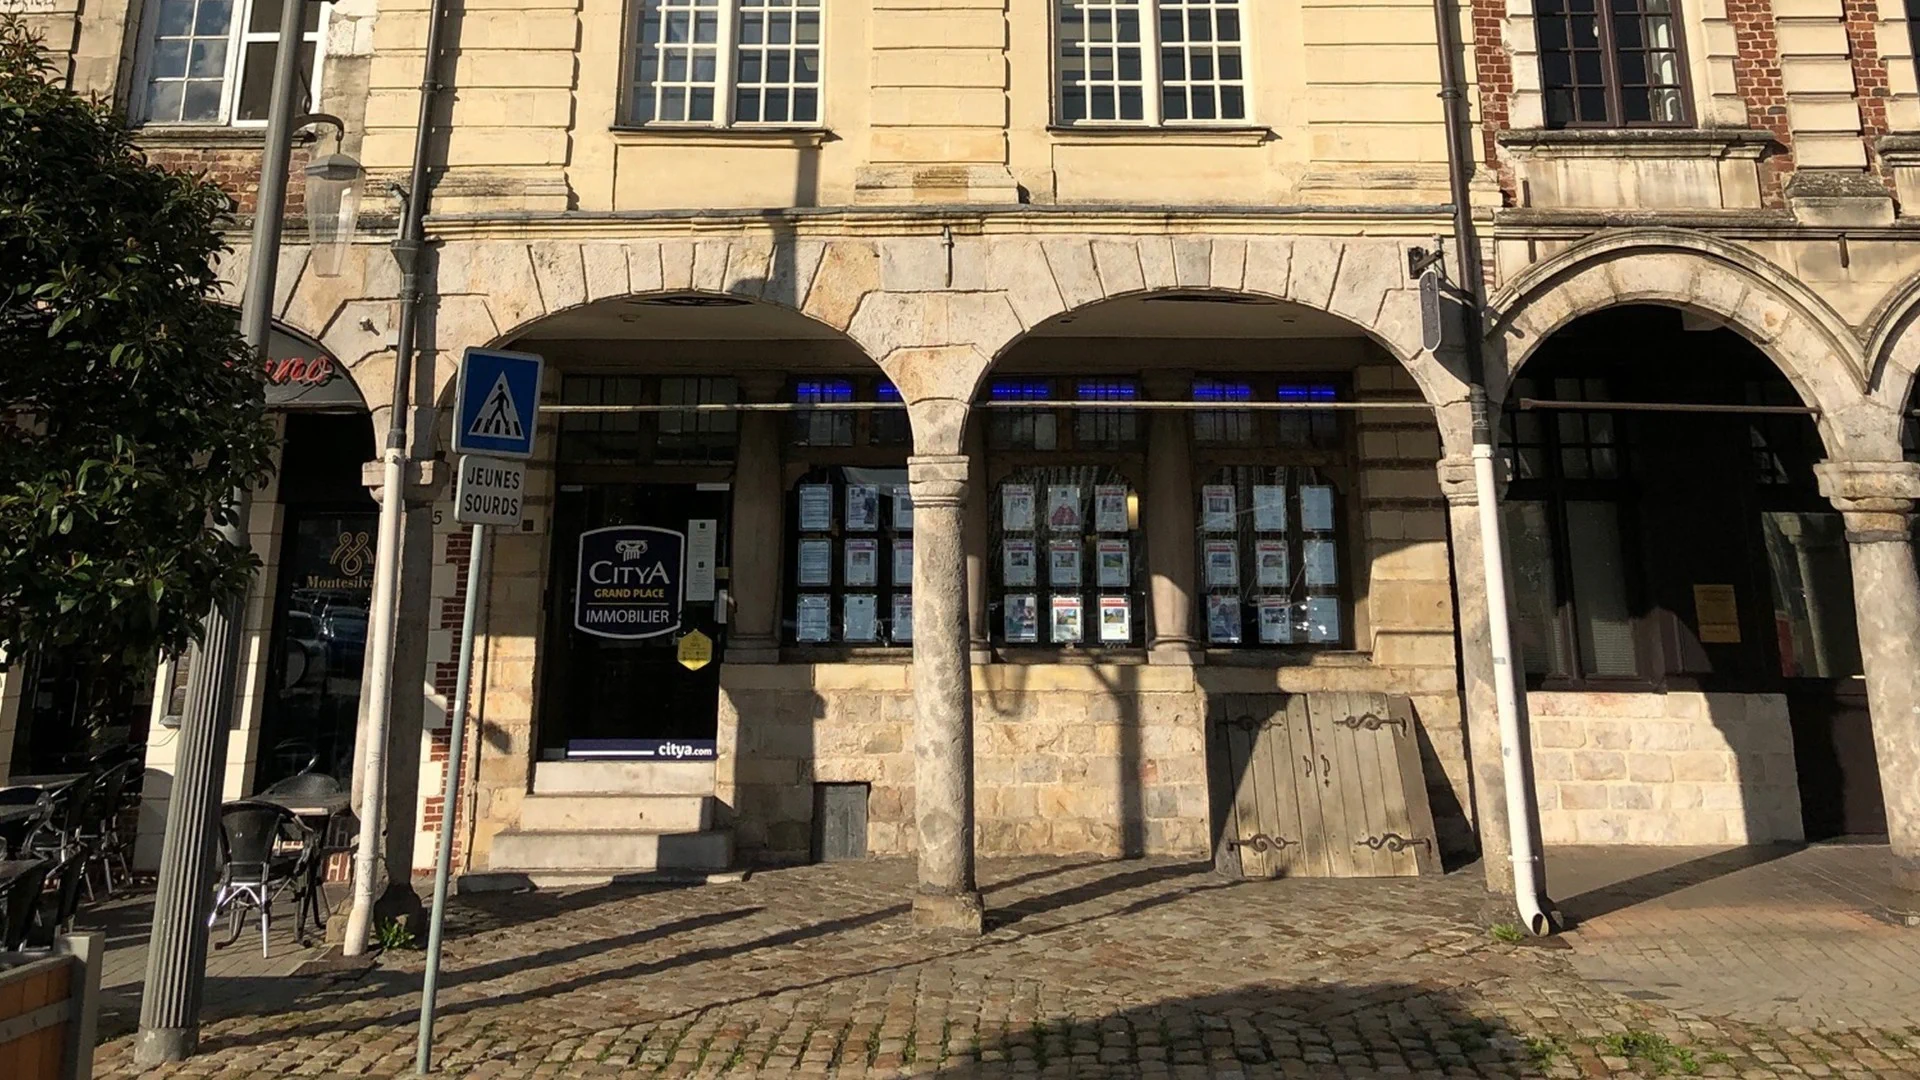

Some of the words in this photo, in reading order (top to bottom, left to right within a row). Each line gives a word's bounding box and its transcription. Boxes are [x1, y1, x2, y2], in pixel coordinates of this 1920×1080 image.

[467, 467, 520, 490] JEUNES
[464, 493, 518, 516] SOURDS
[589, 560, 671, 585] CITYA
[306, 575, 373, 589] Montesilv
[594, 588, 631, 598] GRAND
[633, 588, 665, 598] PLACE
[586, 609, 669, 624] IMMOBILIER
[658, 741, 713, 759] citya.com
